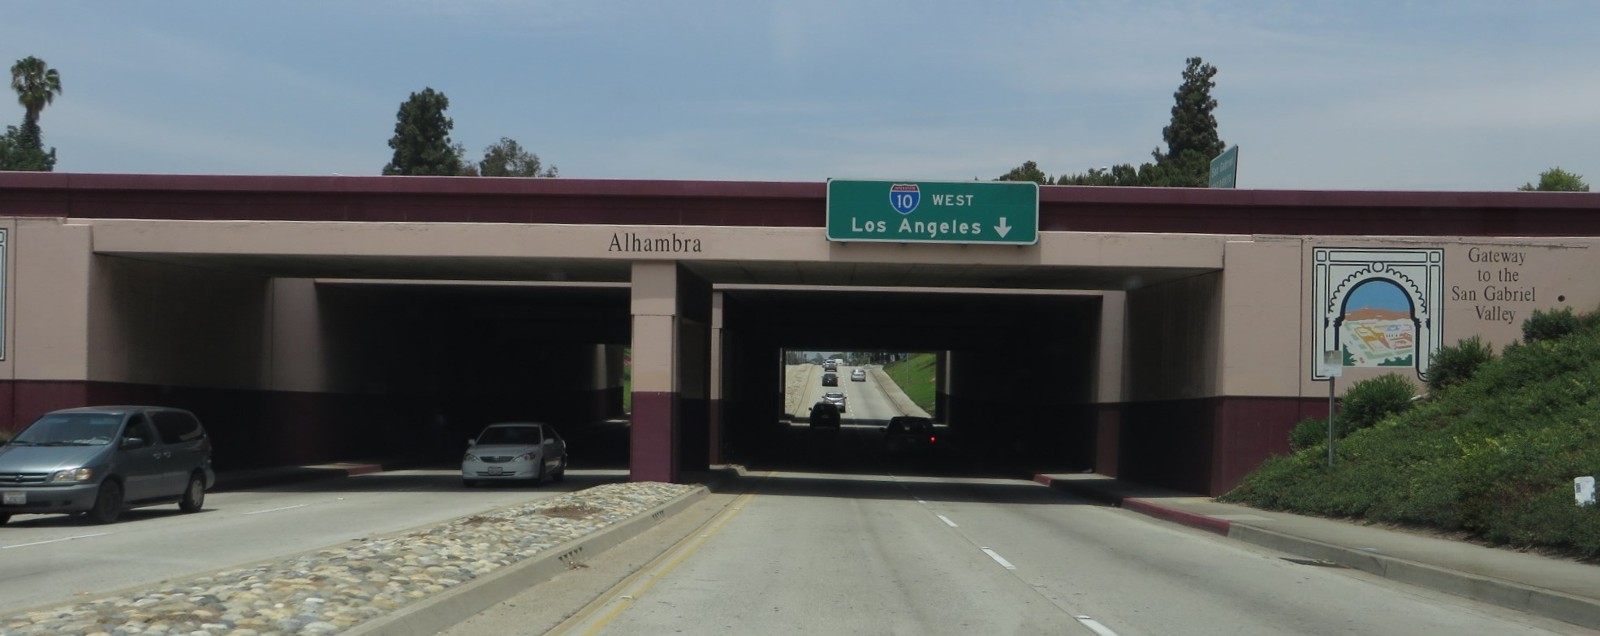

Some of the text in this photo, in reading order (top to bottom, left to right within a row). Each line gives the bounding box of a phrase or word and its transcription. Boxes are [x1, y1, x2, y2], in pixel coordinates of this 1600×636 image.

[897, 194, 974, 209] 10 WEST
[852, 217, 981, 238] Los Angeles
[608, 232, 702, 253] Alhambra
[1468, 247, 1526, 266] Gateway
[1477, 268, 1519, 282] to the
[1451, 285, 1536, 302] San Gabriel
[1475, 305, 1516, 325] Valley
